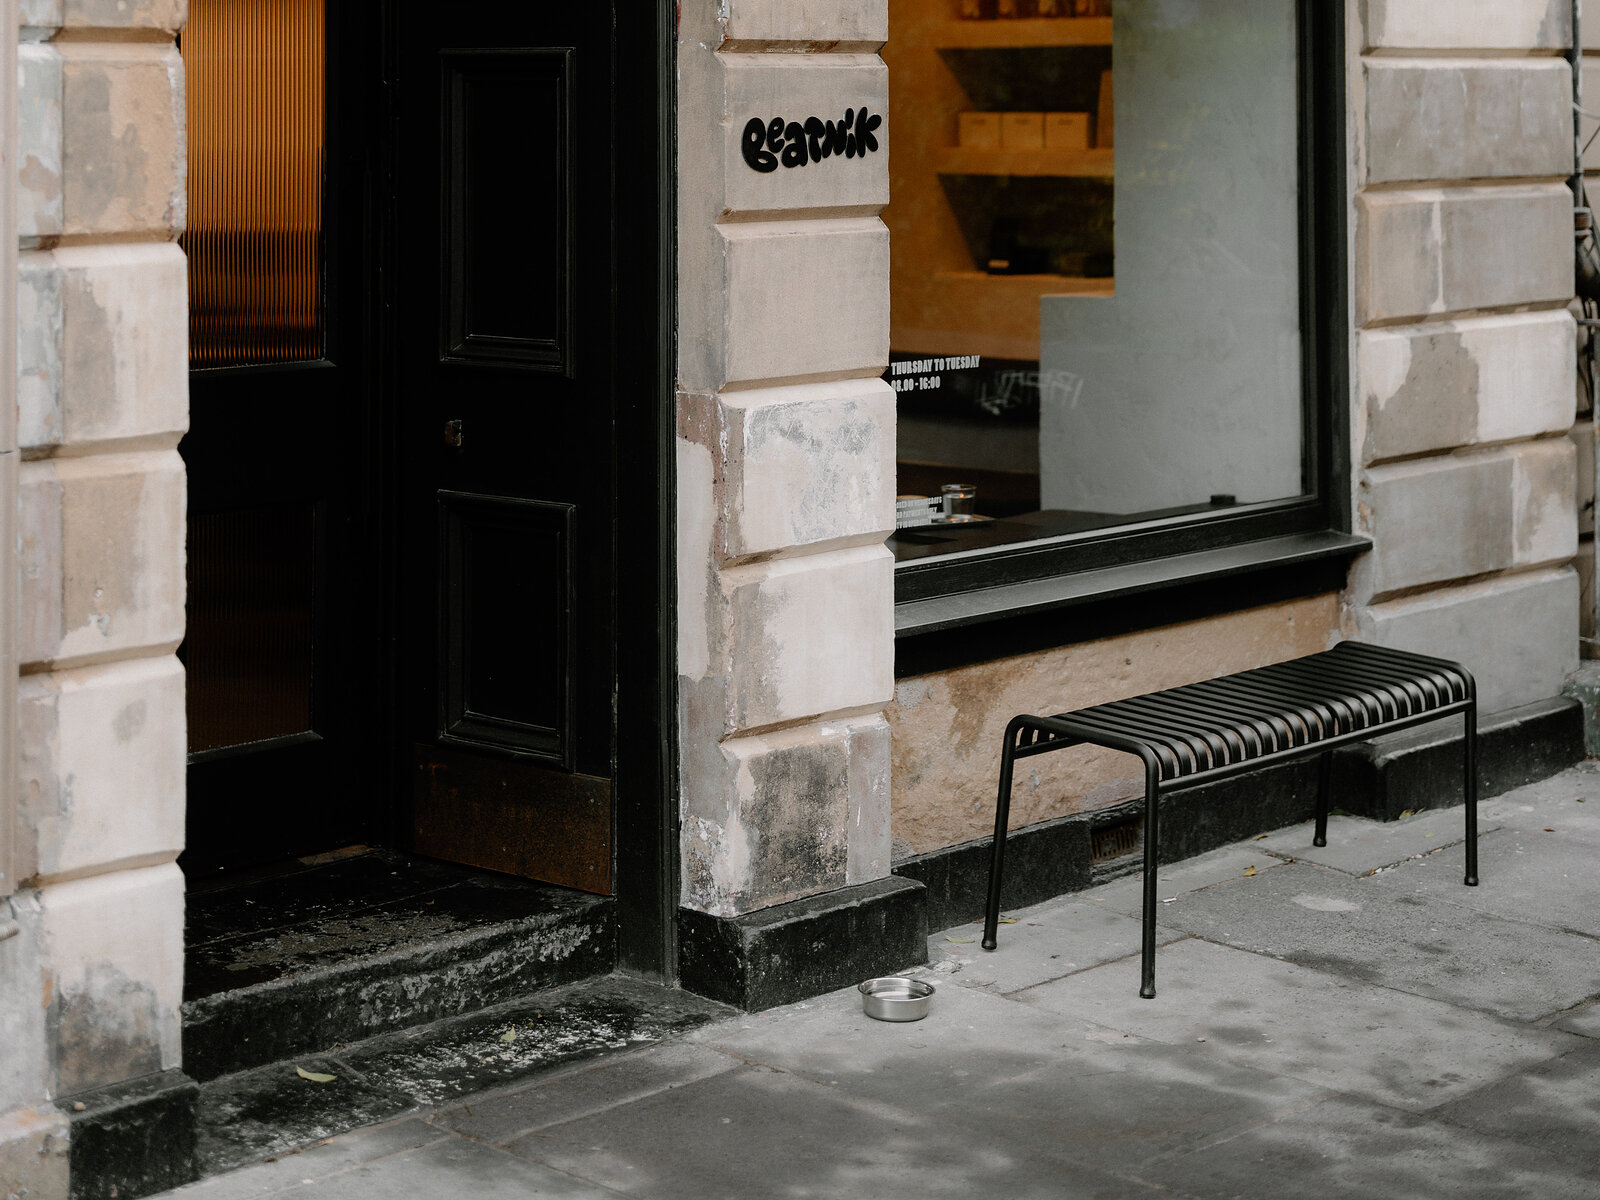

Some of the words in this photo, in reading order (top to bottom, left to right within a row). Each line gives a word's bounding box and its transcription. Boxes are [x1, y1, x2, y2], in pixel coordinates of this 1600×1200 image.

[891, 359, 933, 375] THURSDAY
[934, 359, 945, 371] TO
[945, 355, 980, 370] TUESDAY
